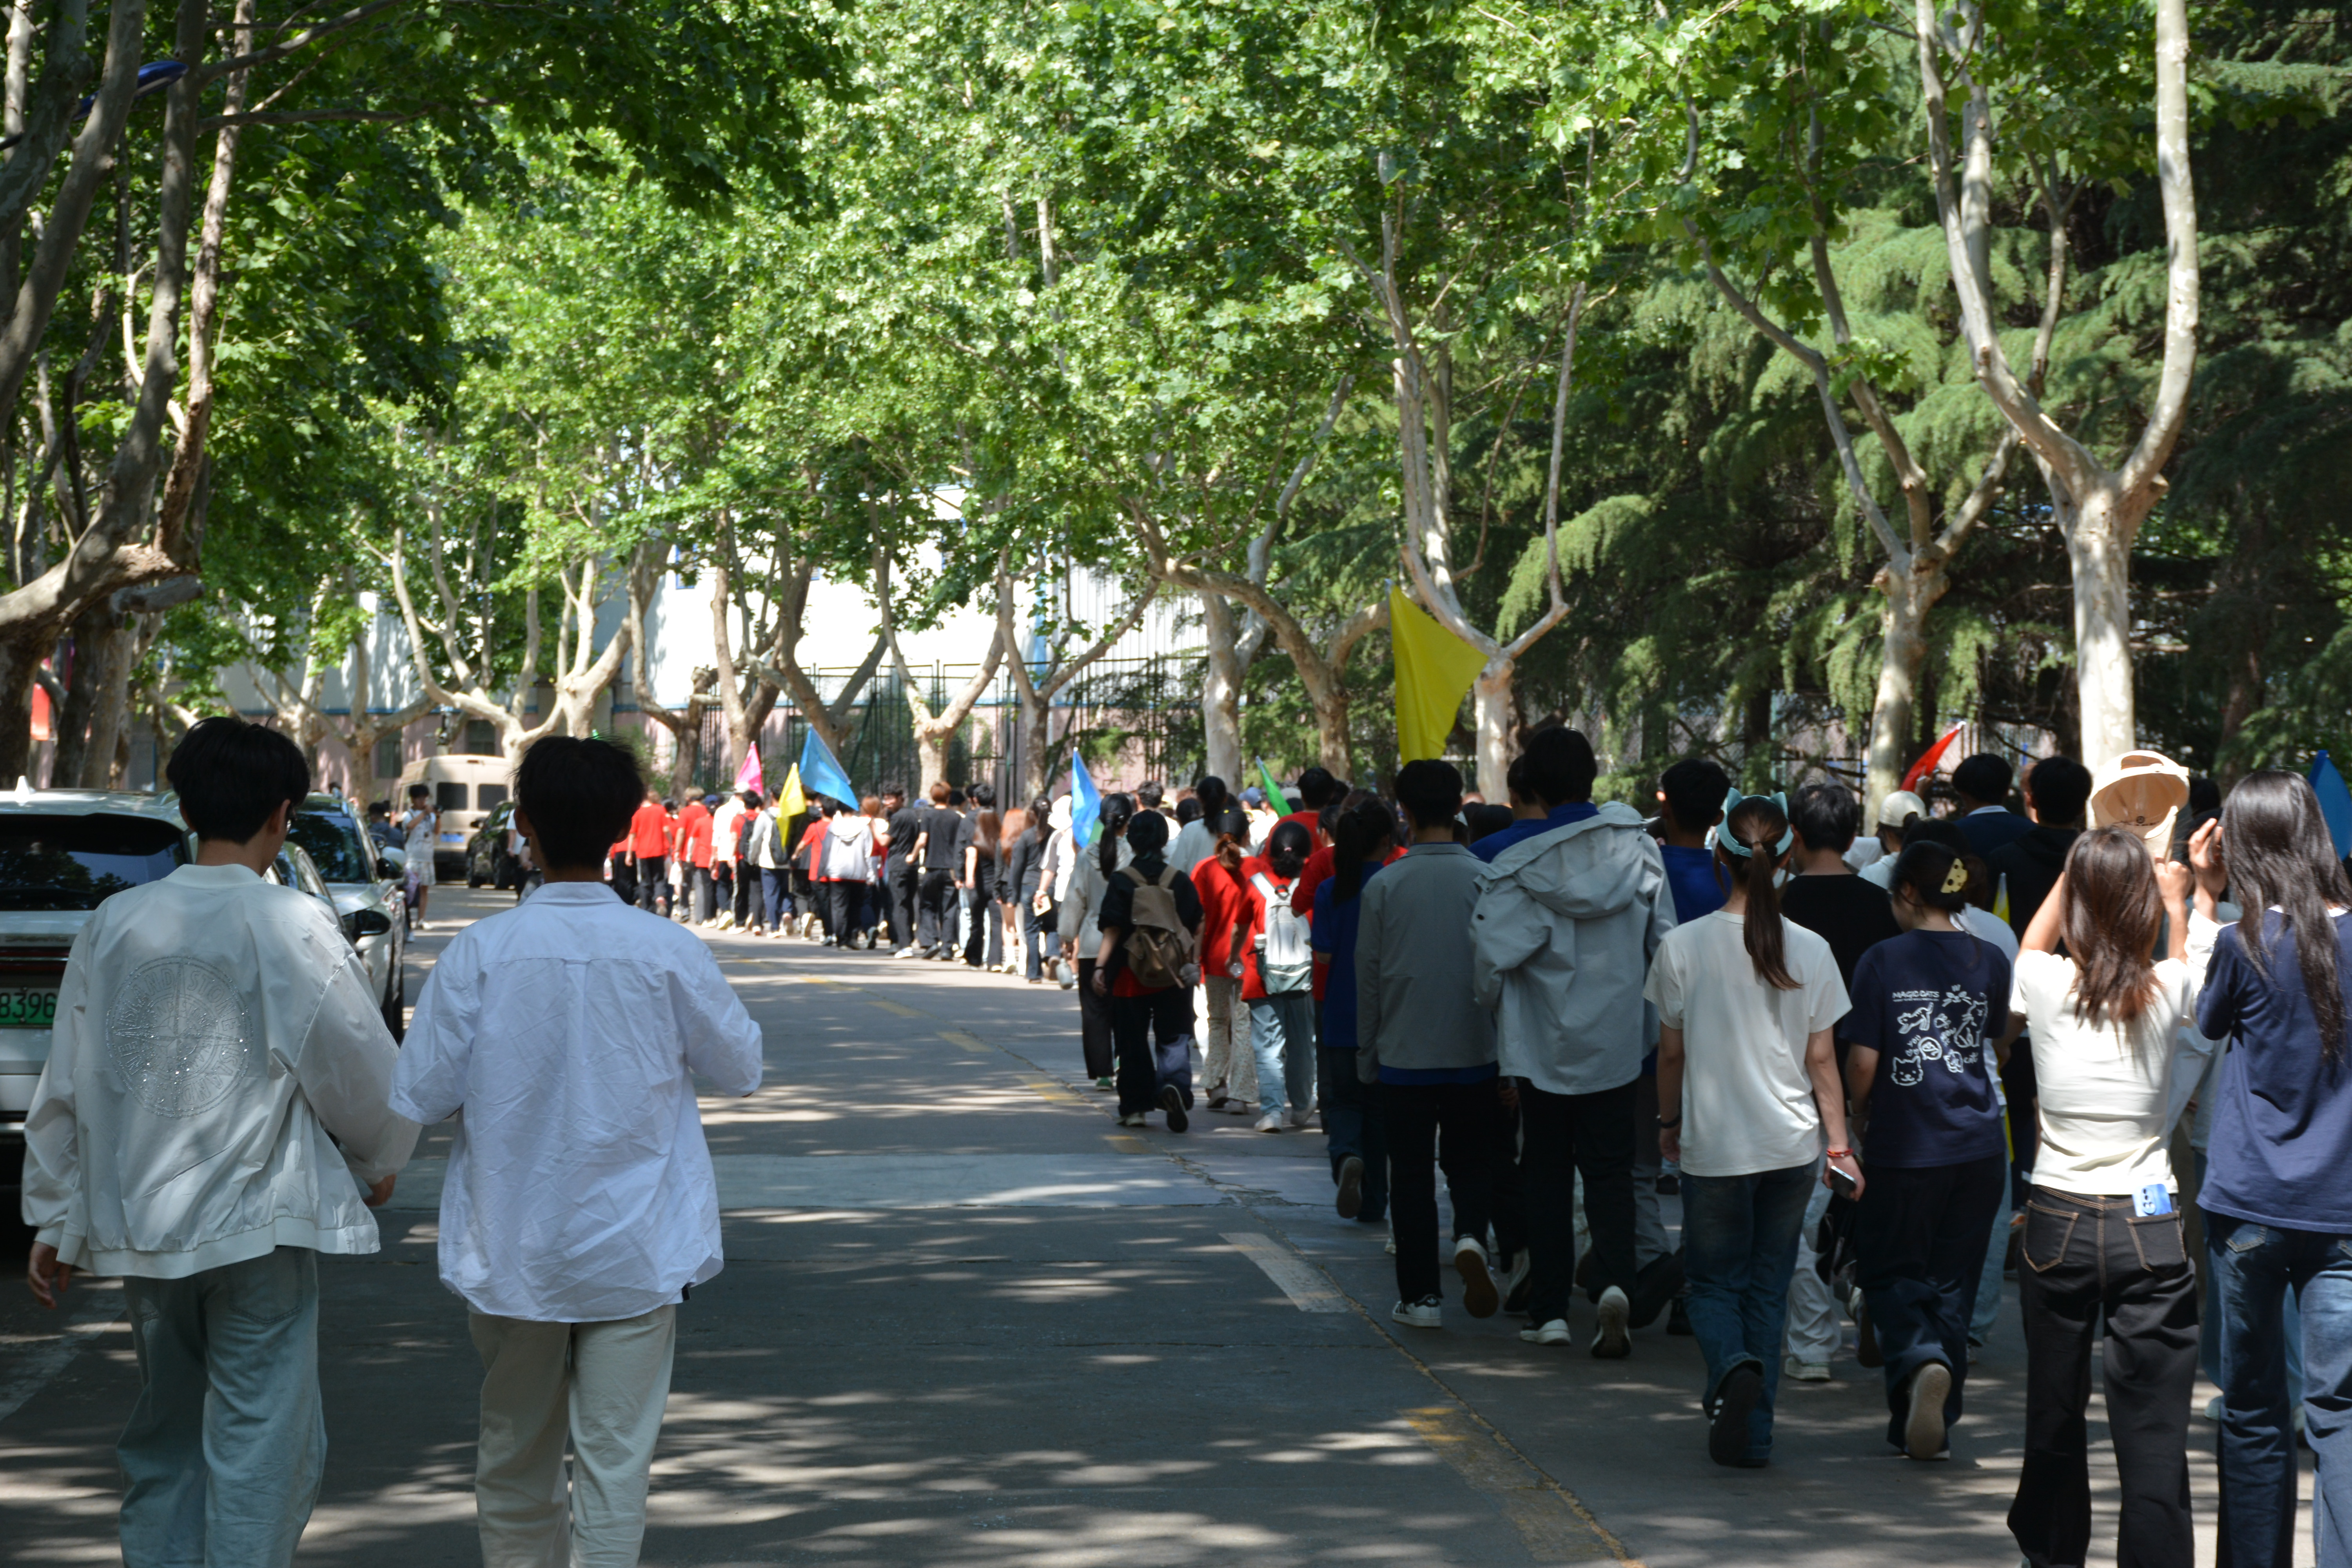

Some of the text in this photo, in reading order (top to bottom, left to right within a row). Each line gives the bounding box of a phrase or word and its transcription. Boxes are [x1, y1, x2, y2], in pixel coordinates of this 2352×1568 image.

[0, 993, 57, 1018] 8396
[118, 968, 175, 1027] ISLAND
[187, 970, 241, 1031] STONE
[182, 1045, 239, 1105] ISLAND
